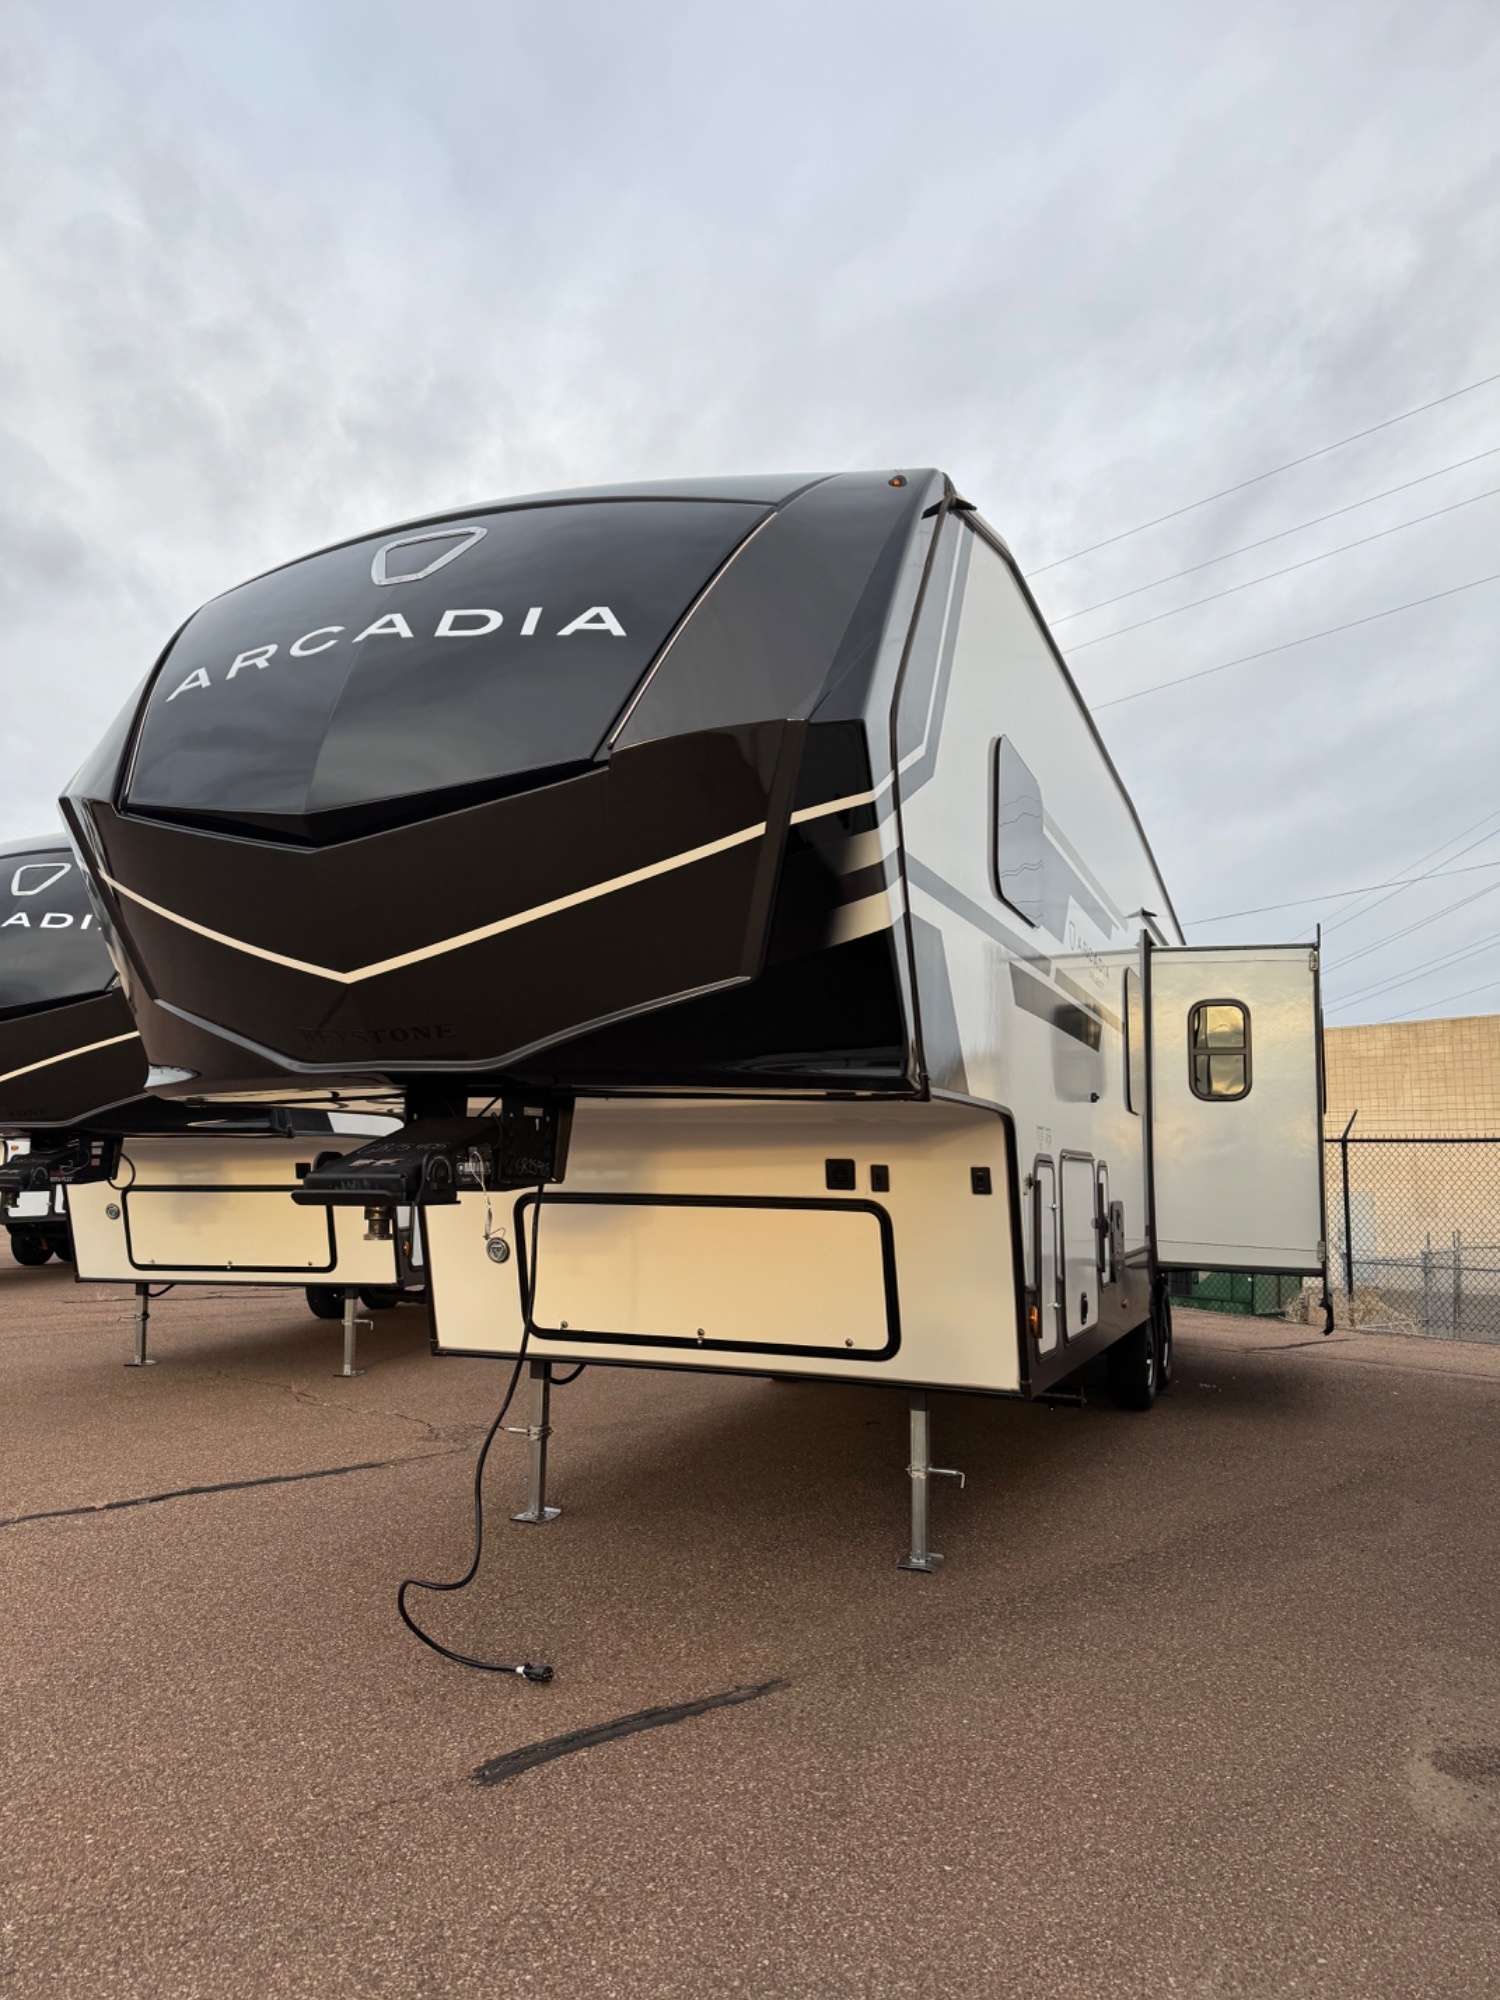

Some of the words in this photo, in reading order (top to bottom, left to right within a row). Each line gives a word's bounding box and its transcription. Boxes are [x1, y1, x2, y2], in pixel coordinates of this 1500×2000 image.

[165, 605, 628, 703] ARCADIA
[0, 911, 102, 930] ADI
[298, 1023, 457, 1044] KEYSTONE
